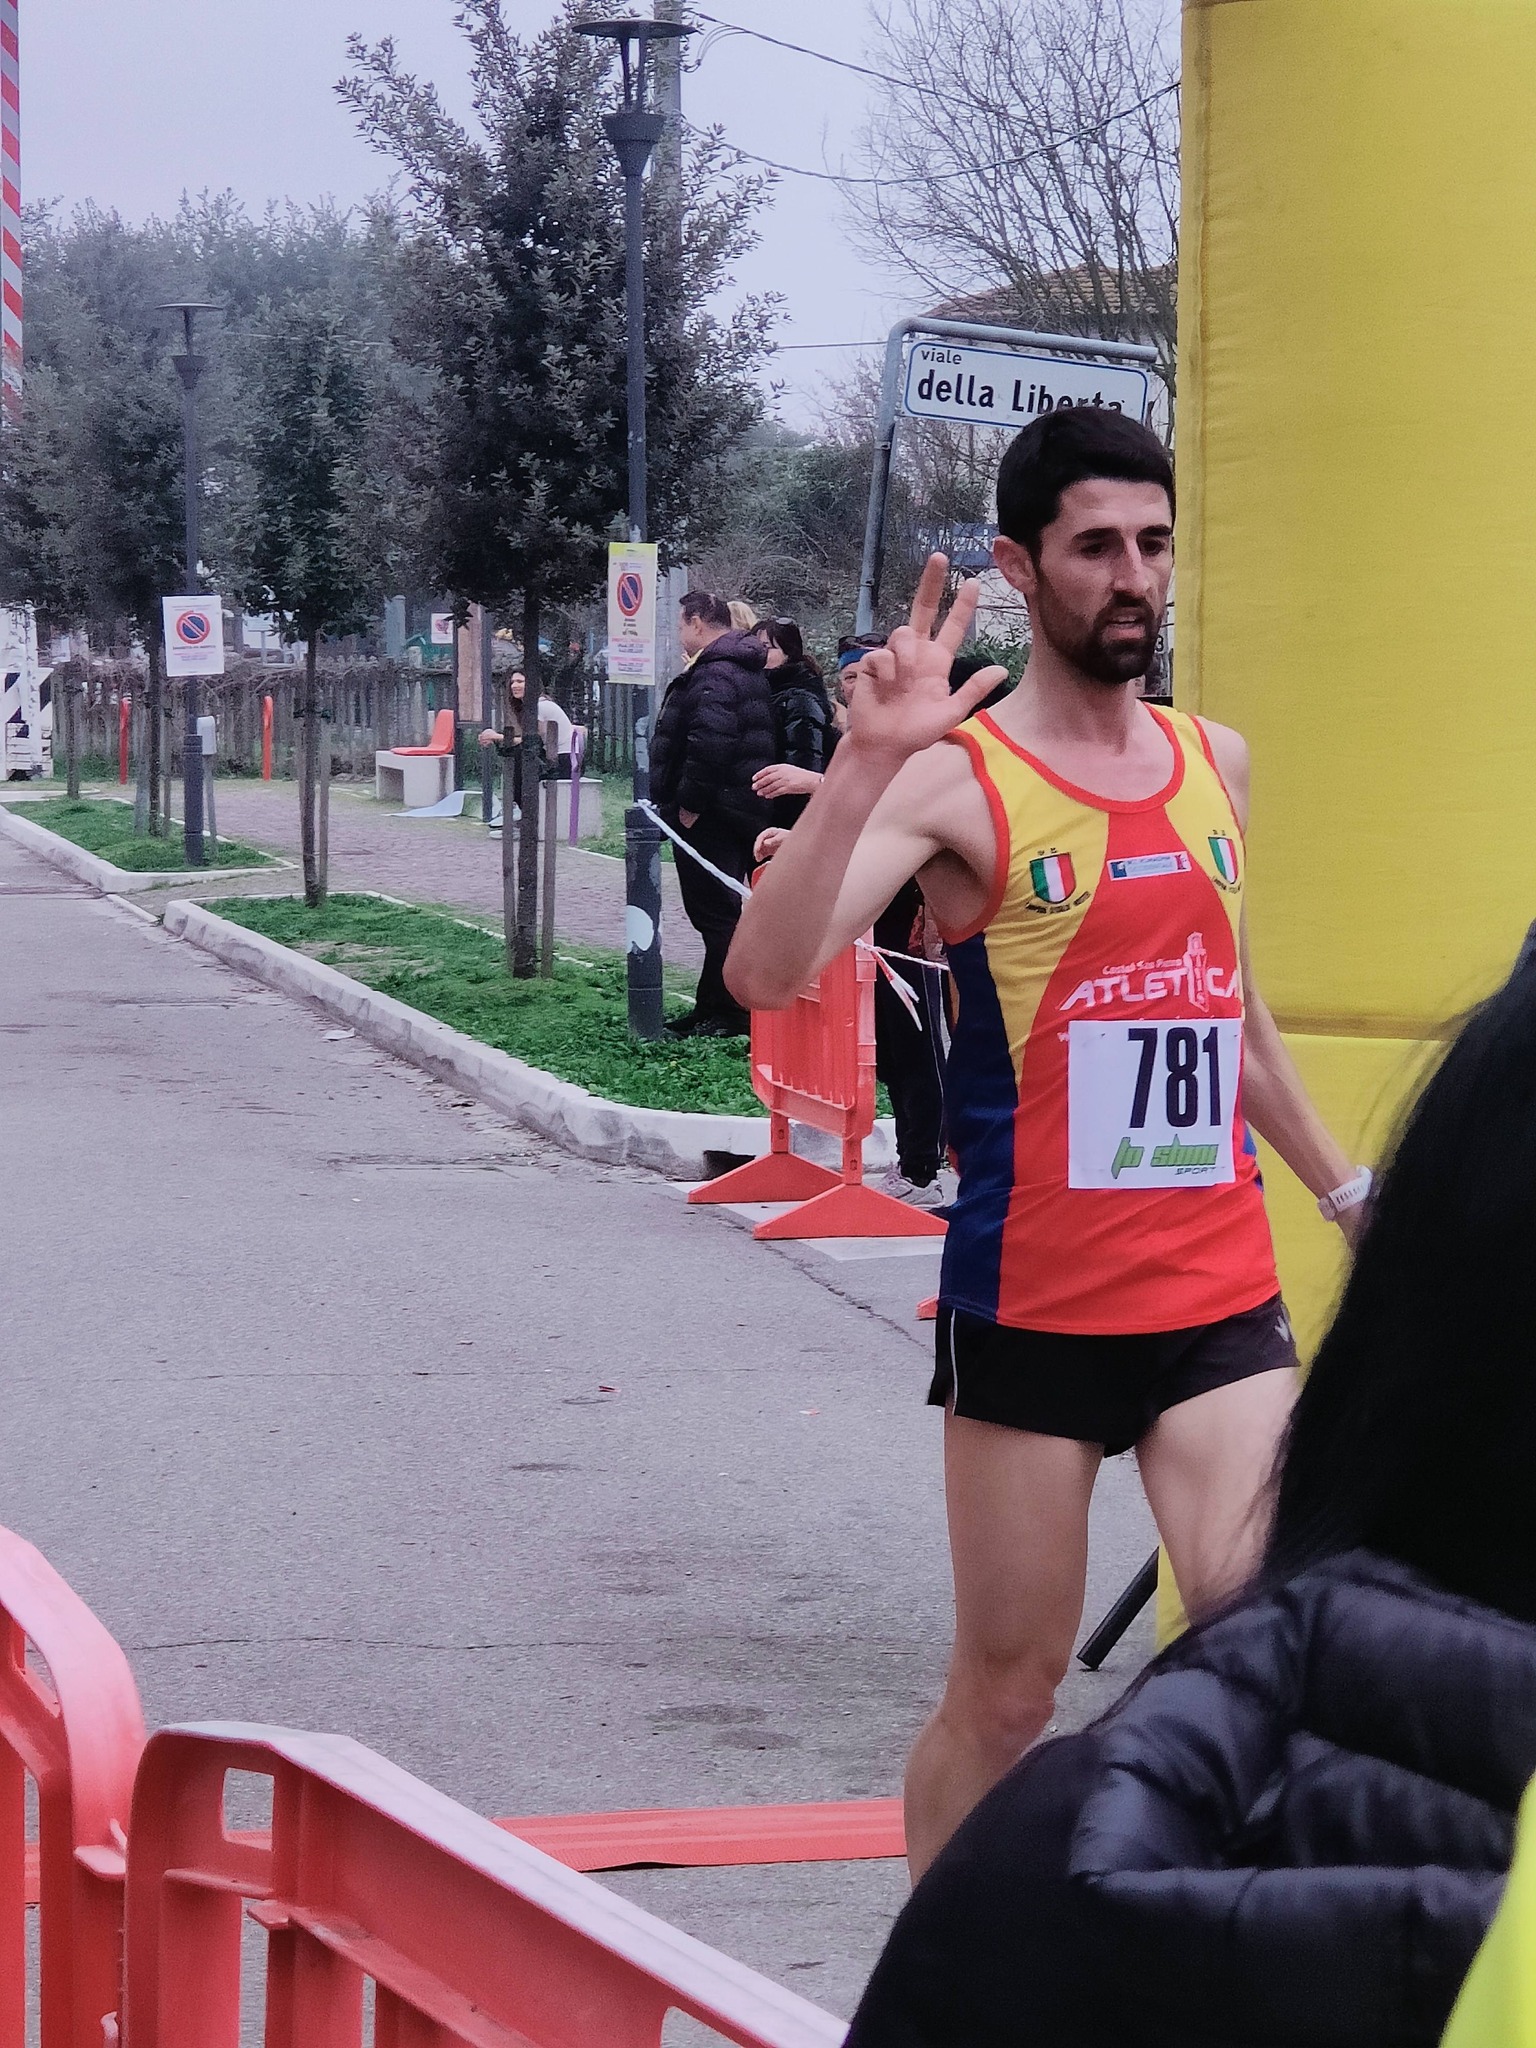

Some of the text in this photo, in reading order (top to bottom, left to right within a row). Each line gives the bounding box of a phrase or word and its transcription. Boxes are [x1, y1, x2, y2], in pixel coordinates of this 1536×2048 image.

[921, 348, 962, 365] viale
[917, 369, 995, 408] della
[1127, 1026, 1222, 1129] 781
[1174, 1166, 1217, 1176] SPORT
